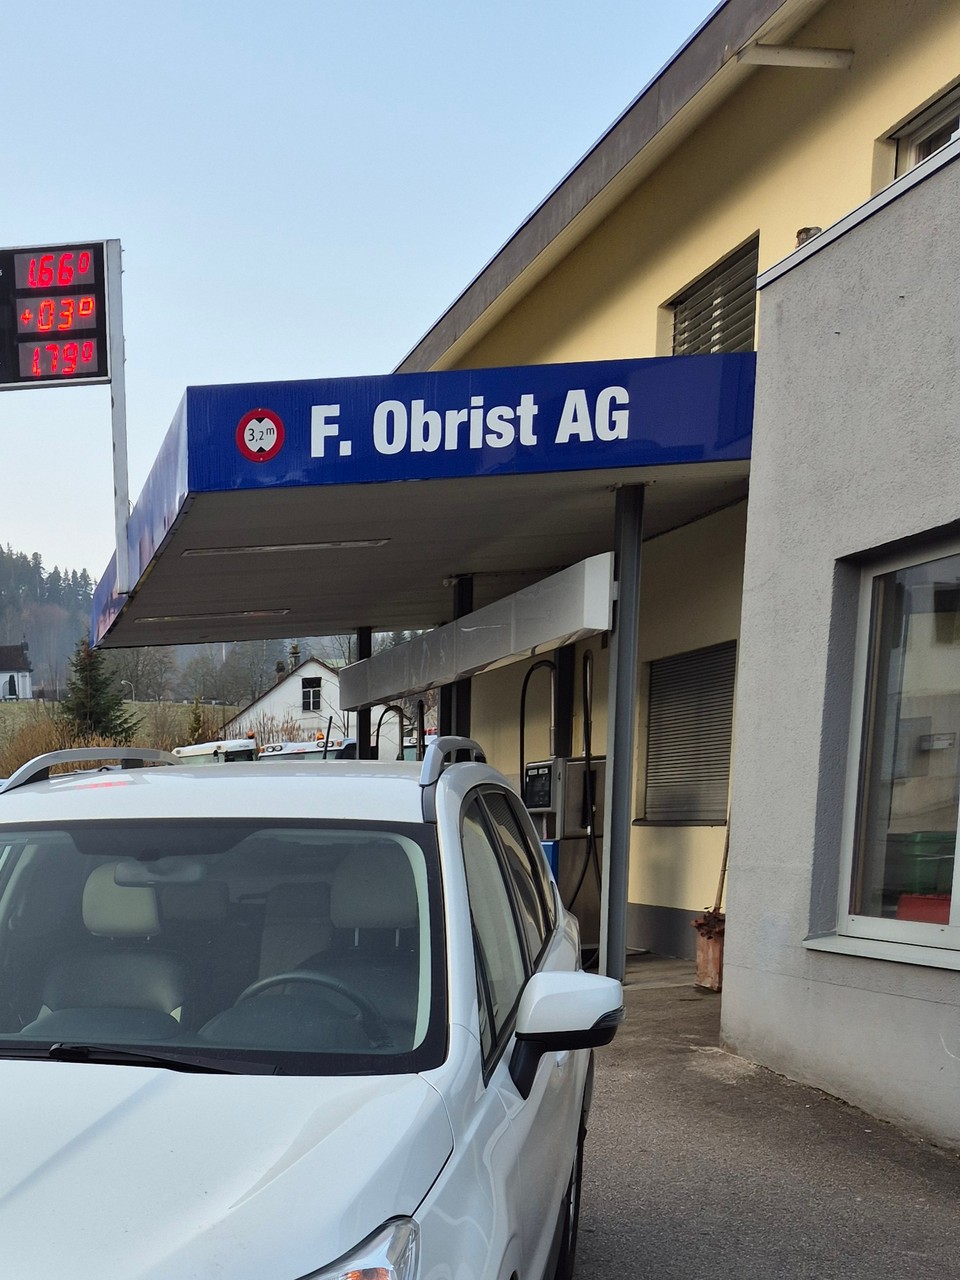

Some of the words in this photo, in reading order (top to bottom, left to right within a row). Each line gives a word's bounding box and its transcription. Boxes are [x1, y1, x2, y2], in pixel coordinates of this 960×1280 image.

[310, 404, 353, 458] F.
[373, 393, 538, 455] Obrist
[555, 385, 631, 444] AG
